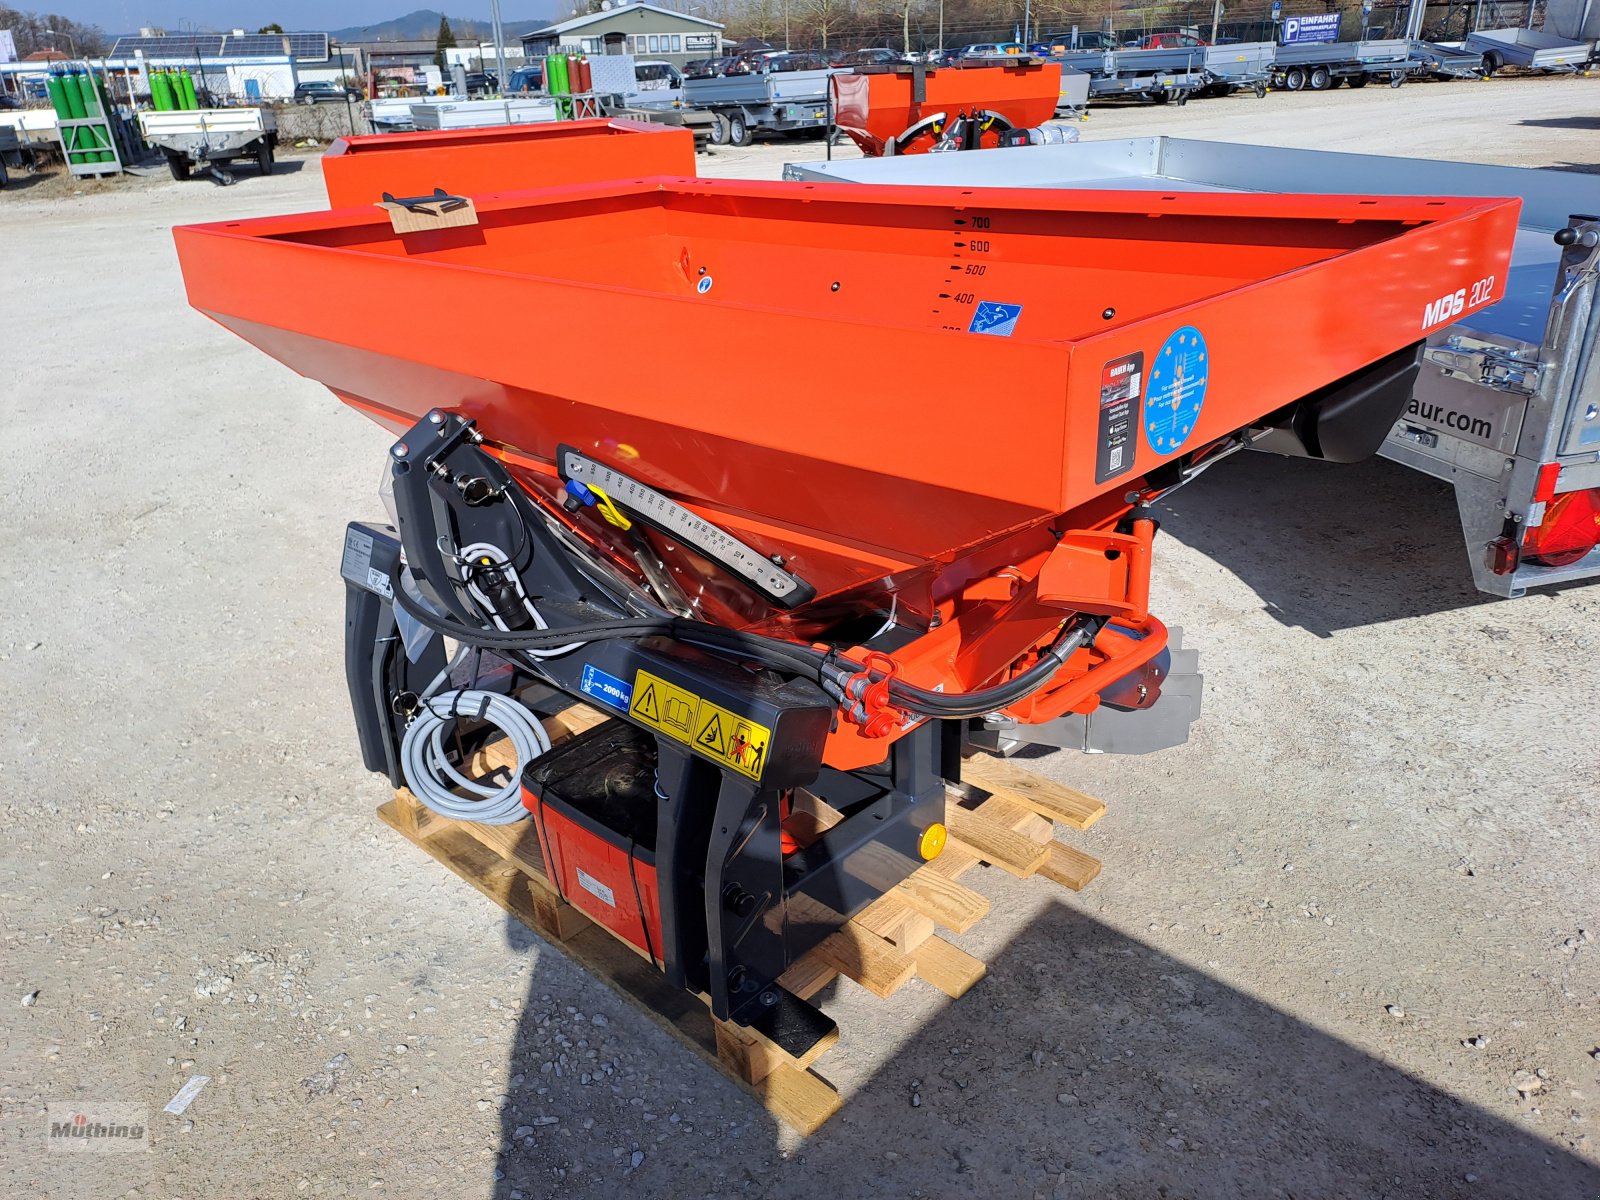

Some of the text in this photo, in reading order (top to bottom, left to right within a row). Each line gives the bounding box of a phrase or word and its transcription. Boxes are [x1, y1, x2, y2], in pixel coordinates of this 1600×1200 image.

[1300, 14, 1339, 25] EINFAHRT
[1286, 20, 1298, 40] P
[971, 216, 990, 229] 700
[970, 240, 990, 252] 600
[965, 265, 986, 276] 500
[954, 293, 975, 304] 400
[1422, 275, 1494, 330] MDS 202
[1127, 363, 1135, 373] App
[658, 499, 666, 511] 250
[693, 521, 702, 530] 100
[602, 684, 620, 698] 2000
[620, 691, 629, 703] kg
